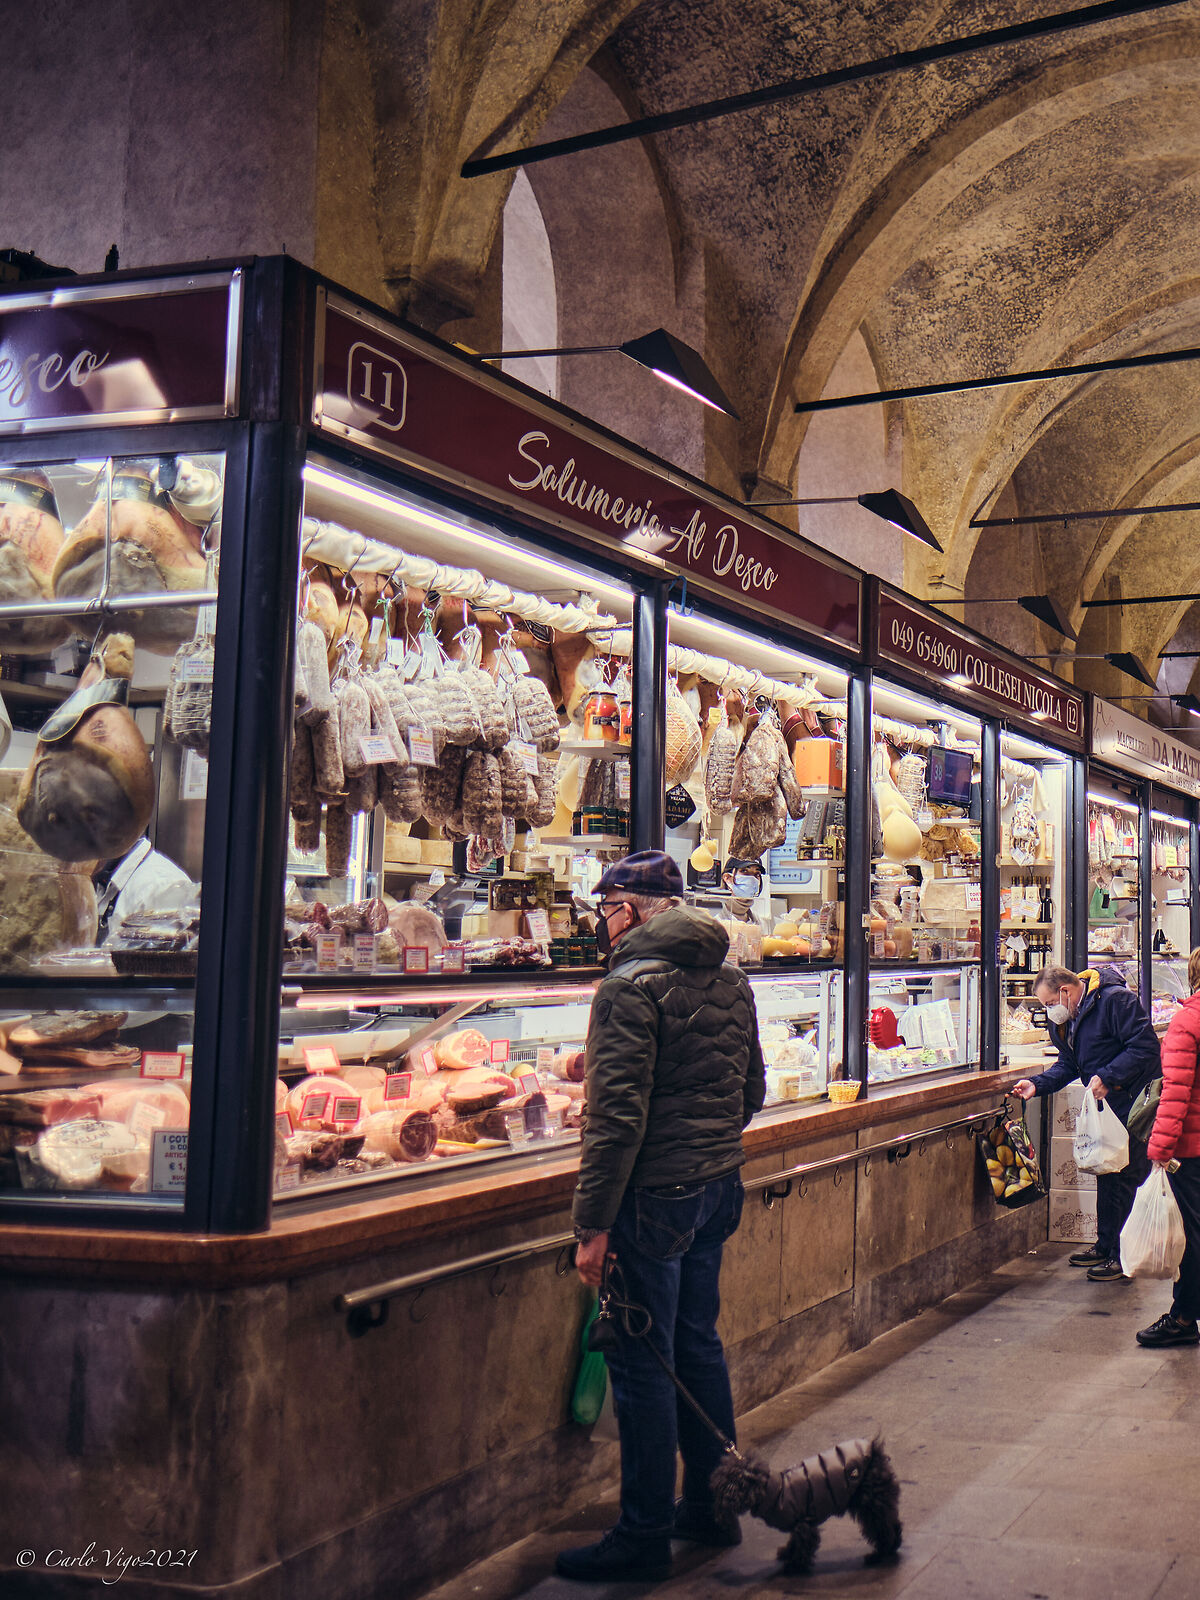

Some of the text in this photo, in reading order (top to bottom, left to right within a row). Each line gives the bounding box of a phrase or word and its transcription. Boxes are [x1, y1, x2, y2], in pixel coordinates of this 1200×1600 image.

[360, 361, 395, 412] 11
[508, 430, 779, 592] Salumeria Al Desco
[891, 618, 1062, 723] 049 654960 COLLESEI NICOLA
[1067, 705, 1077, 726] 12
[1151, 736, 1169, 767] DA
